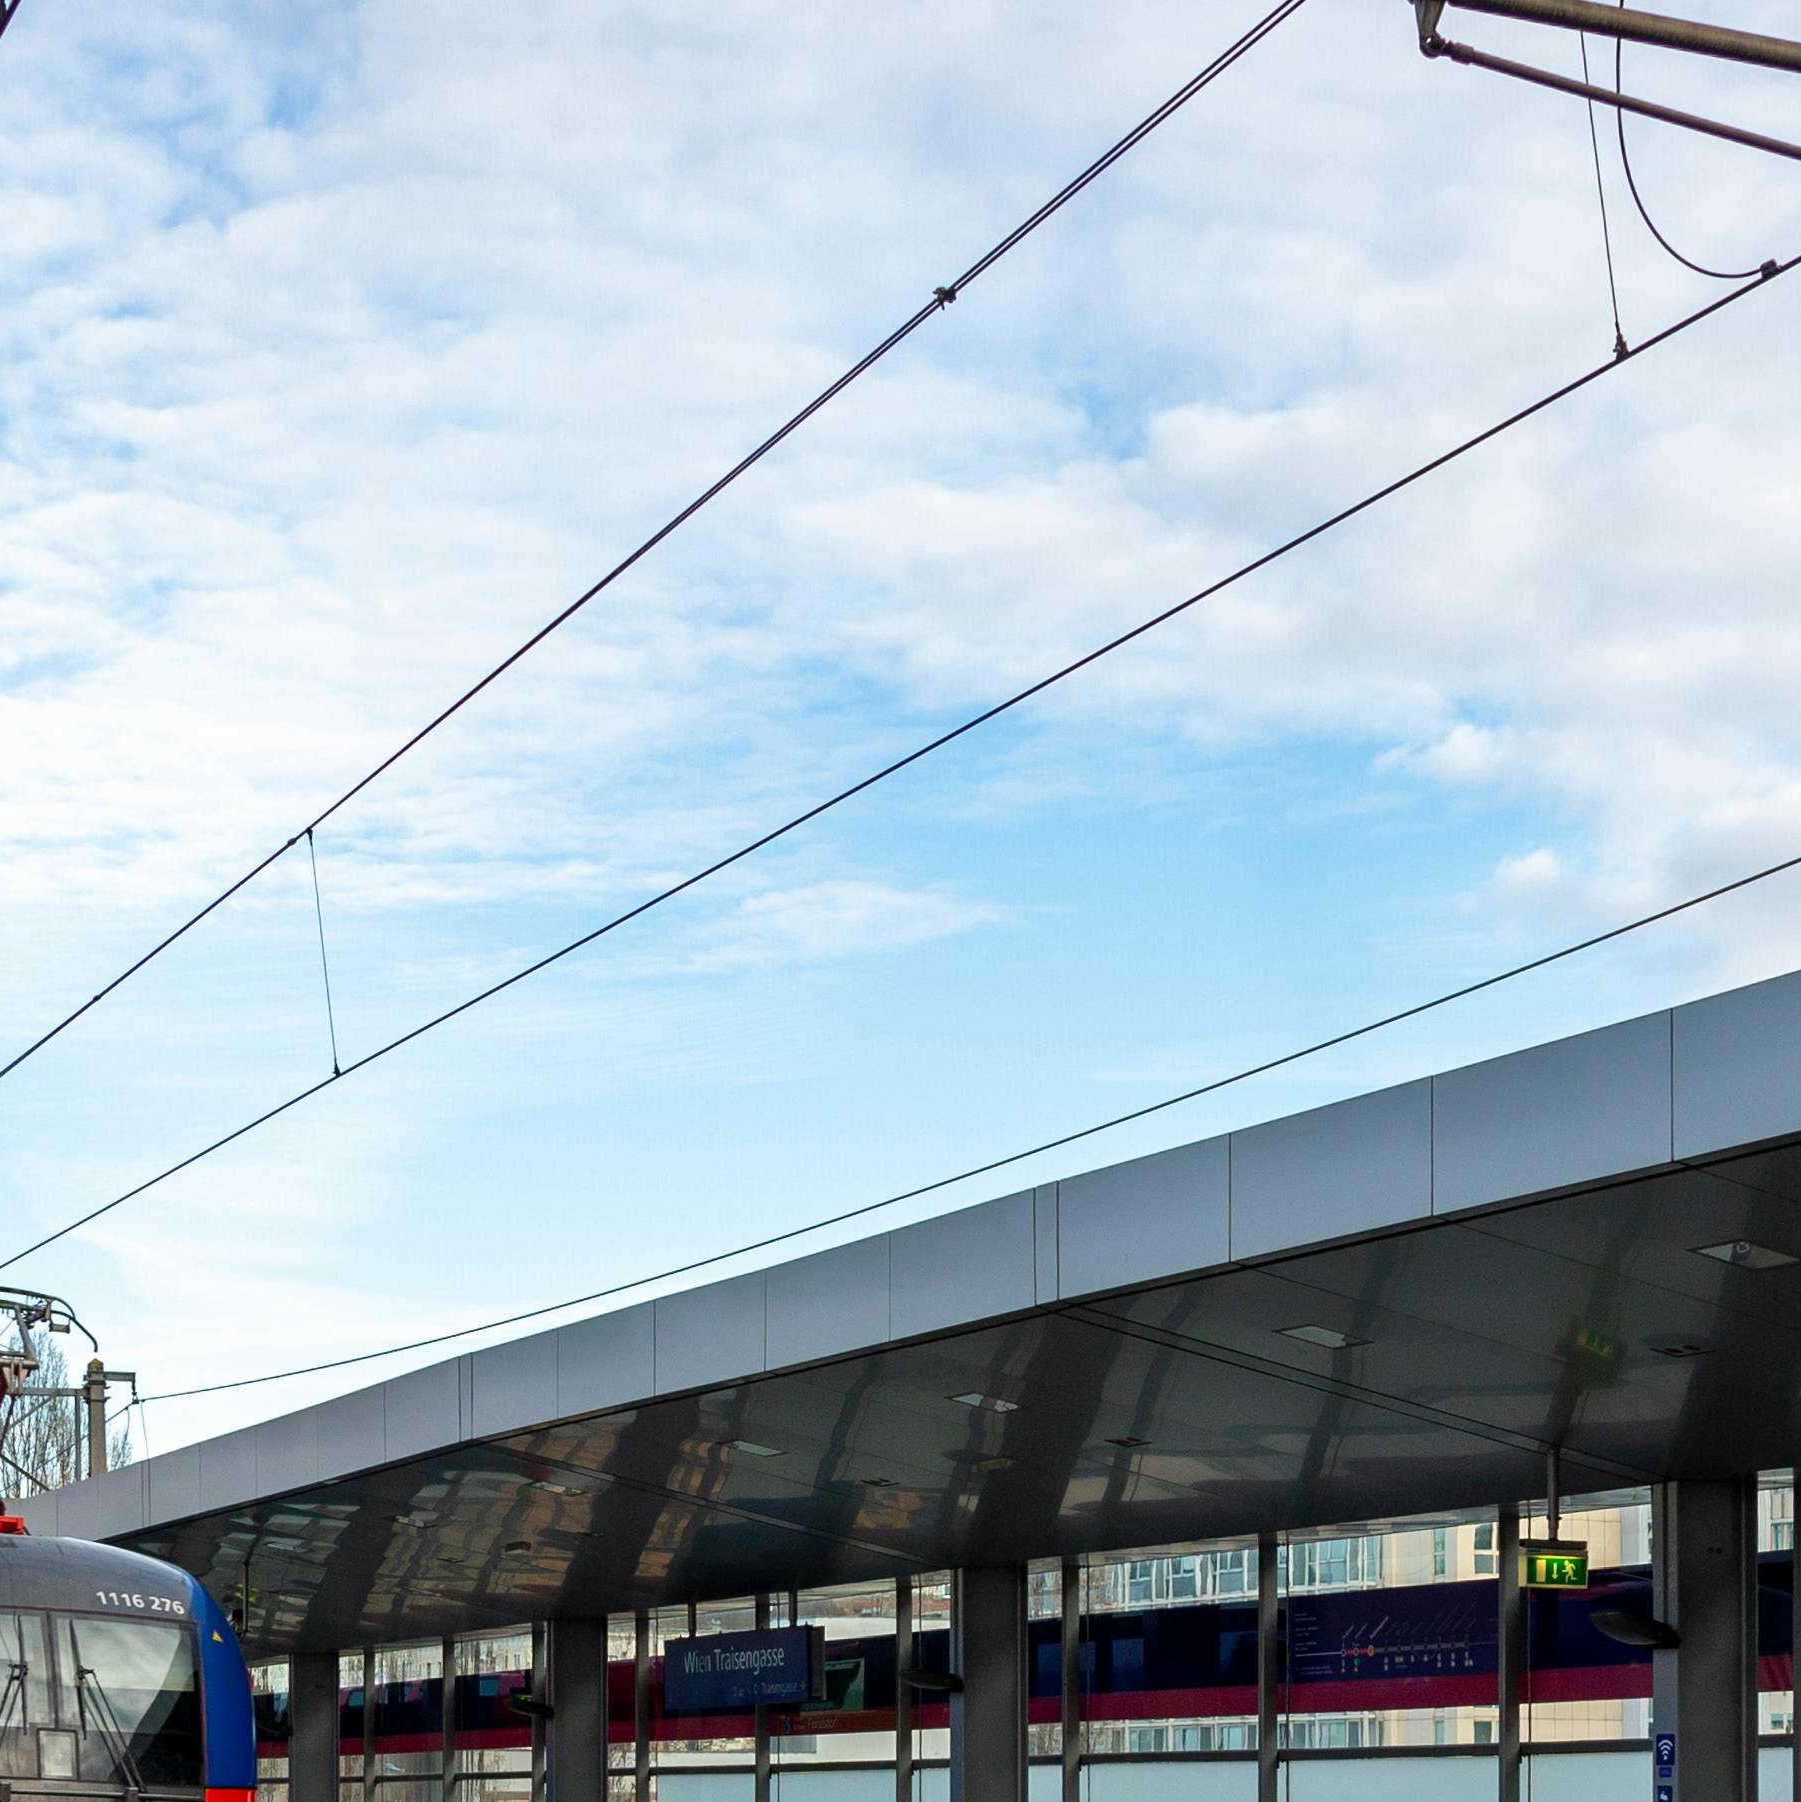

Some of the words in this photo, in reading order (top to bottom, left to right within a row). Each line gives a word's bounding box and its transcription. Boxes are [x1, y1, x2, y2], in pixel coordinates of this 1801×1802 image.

[95, 1590, 145, 1609] 1116
[149, 1595, 185, 1615] 276
[684, 1648, 712, 1674] Wien
[713, 1646, 786, 1675] Traisengasse
